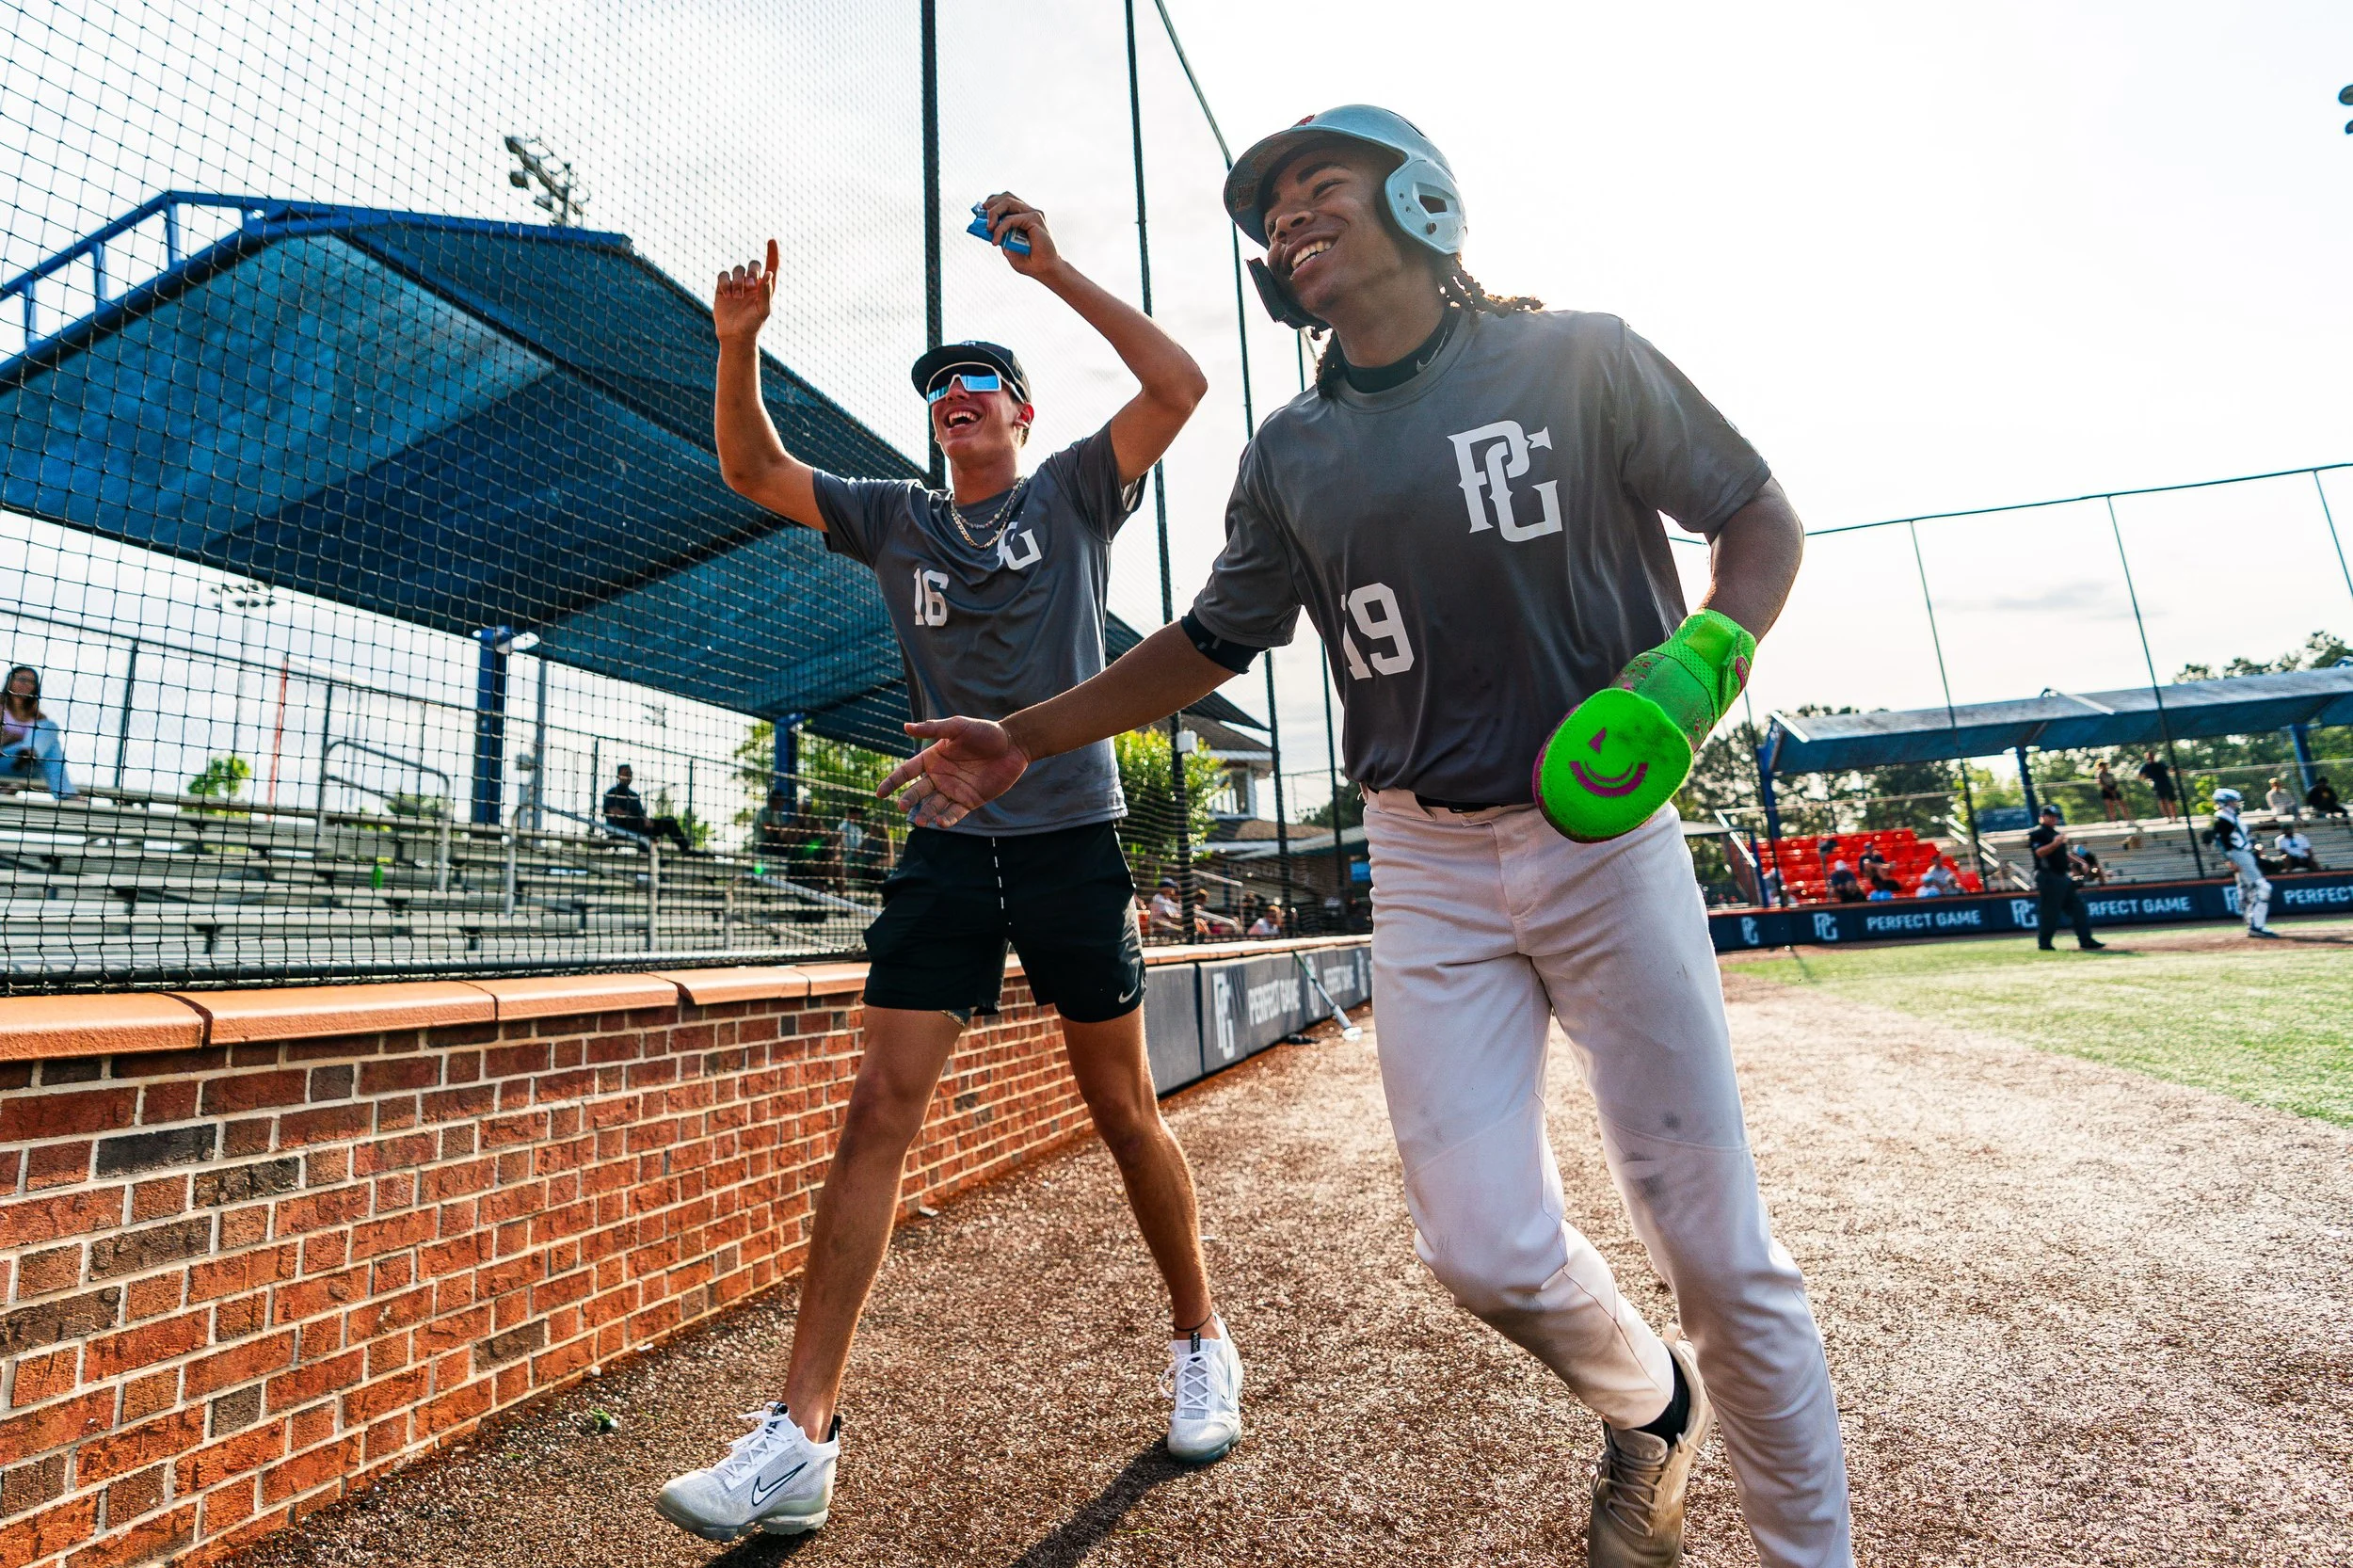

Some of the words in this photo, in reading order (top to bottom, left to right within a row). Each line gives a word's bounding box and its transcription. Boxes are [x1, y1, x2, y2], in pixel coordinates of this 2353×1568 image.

[1447, 420, 1562, 542] PG
[914, 568, 949, 627] 16
[1340, 582, 1415, 680] 19
[1813, 912, 1838, 940] PG
[1866, 913, 1931, 932] PERFECT
[1936, 909, 1981, 927] GAME
[2088, 899, 2138, 917] RFECT
[2142, 896, 2191, 914] GAME
